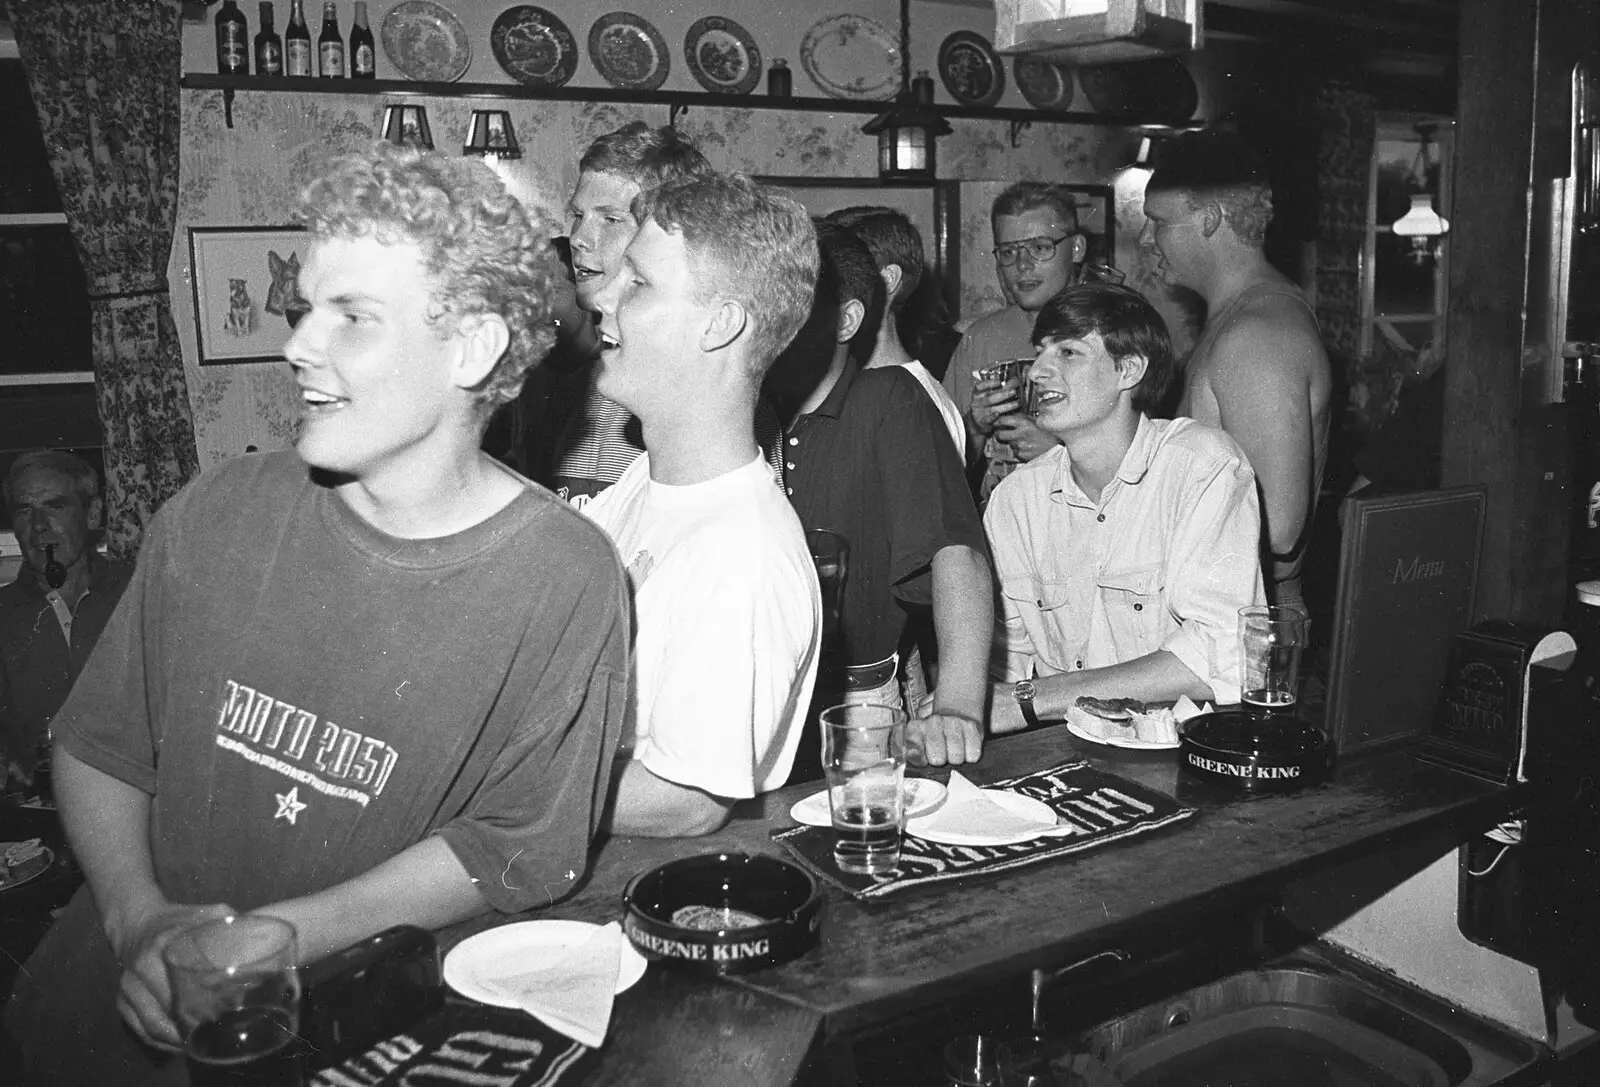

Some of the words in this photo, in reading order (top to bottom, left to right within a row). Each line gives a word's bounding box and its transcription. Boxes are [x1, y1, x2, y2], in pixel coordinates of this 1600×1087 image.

[1391, 555, 1445, 584] Menu
[1188, 753, 1252, 778] GREENE
[1256, 766, 1300, 779] KING
[630, 926, 708, 961] GREENE
[711, 938, 770, 961] KING
